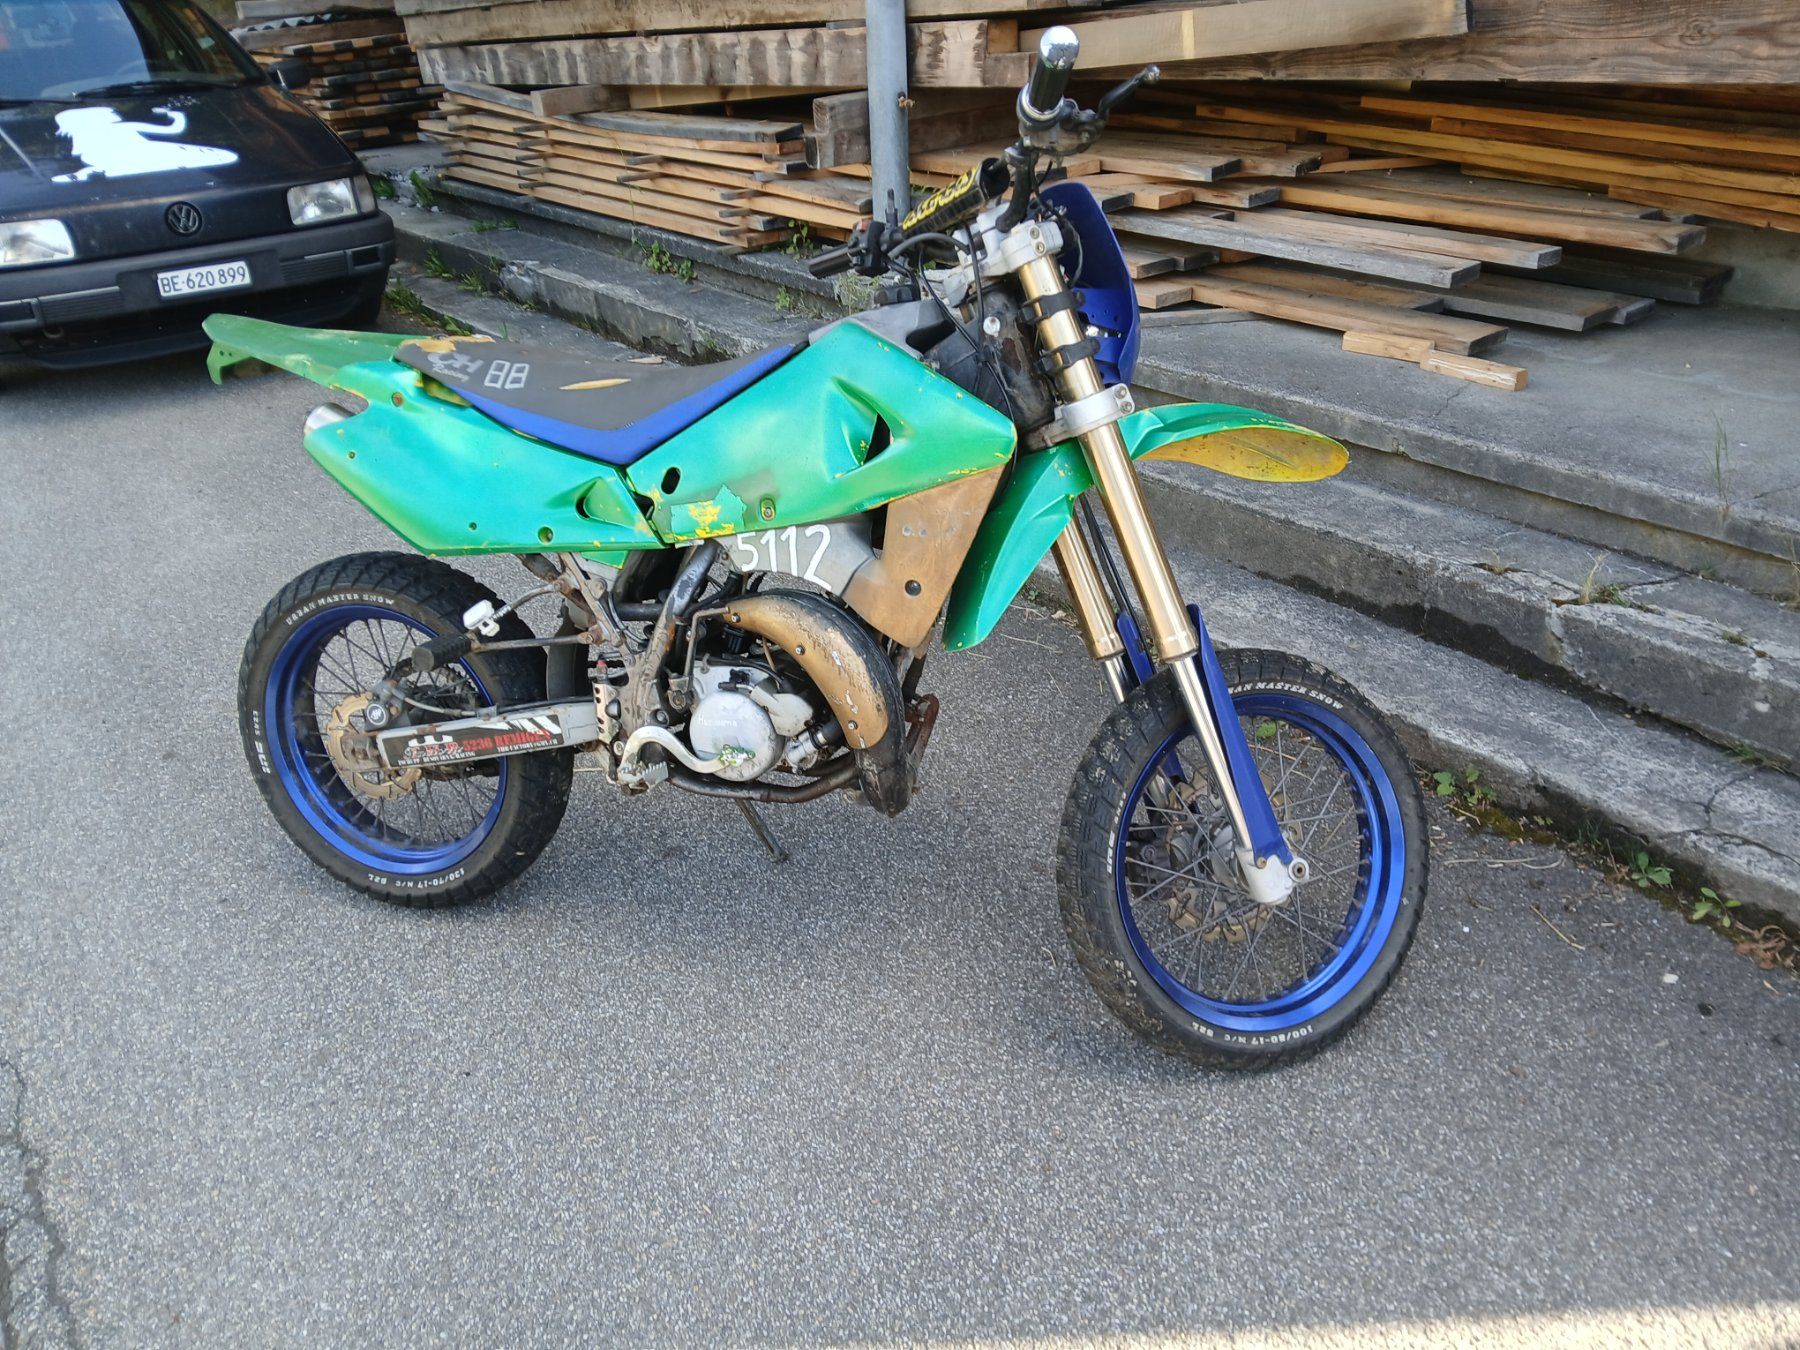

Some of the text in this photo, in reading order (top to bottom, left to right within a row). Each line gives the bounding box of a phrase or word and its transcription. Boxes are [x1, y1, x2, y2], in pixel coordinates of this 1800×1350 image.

[484, 360, 530, 389] 88
[736, 524, 832, 591] 5112
[286, 593, 395, 625] URBAN MASTER SNOW
[1255, 682, 1307, 694] MASTER
[1309, 690, 1344, 709] SNOW
[417, 867, 465, 889] 130/70-17
[1251, 1025, 1314, 1045] 100/80-17
